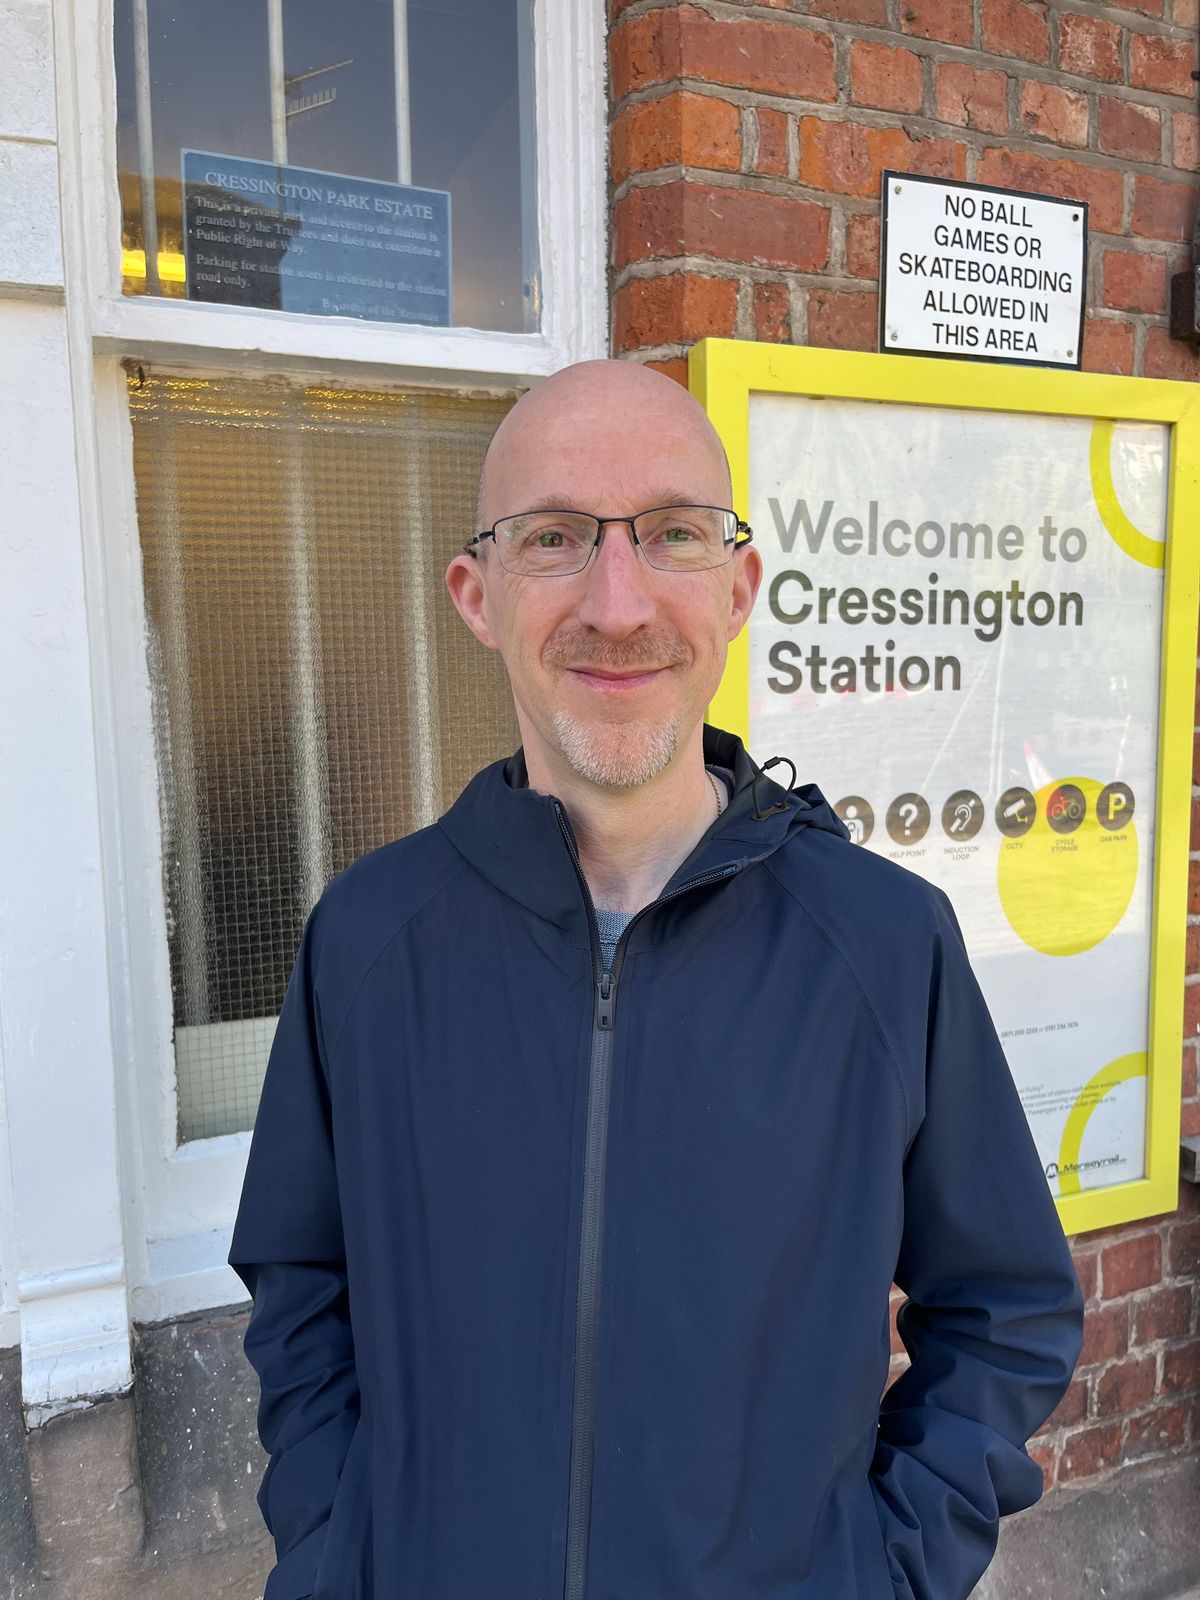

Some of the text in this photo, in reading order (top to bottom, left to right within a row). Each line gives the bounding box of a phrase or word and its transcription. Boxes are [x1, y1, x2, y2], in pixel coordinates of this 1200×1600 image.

[204, 171, 433, 220] CRESSINGTON PARK ESTATE
[194, 195, 219, 208] This
[222, 200, 232, 211] is
[234, 205, 241, 213] a
[243, 206, 281, 218] private
[283, 211, 305, 222] park
[309, 215, 328, 226] and
[364, 224, 375, 233] to
[376, 224, 393, 236] the
[944, 194, 1033, 228] NO BALL
[195, 215, 236, 228] granted
[239, 218, 253, 233] by
[255, 221, 272, 233] the
[274, 223, 318, 240] Trustees
[196, 228, 231, 243] Public
[233, 233, 263, 249] Right
[265, 239, 278, 250] of
[934, 224, 1042, 260] GAMES OR
[196, 253, 238, 272] Parking
[241, 259, 257, 272] for
[259, 264, 294, 276] station
[898, 252, 1072, 294] SKATEBOARDING
[196, 272, 251, 289] road only.
[923, 289, 1049, 324] ALLOWED IN
[932, 322, 1039, 353] THIS AREA
[767, 497, 1087, 563] Welcome to
[768, 569, 1083, 642] Cressington
[767, 639, 961, 695] Station
[906, 849, 926, 857] POINT
[943, 845, 980, 855] INDUCTION
[1005, 841, 1024, 850] CCTV
[1055, 838, 1075, 847] CYCLE
[952, 853, 970, 861] LOOP
[1063, 1154, 1120, 1173] Merseyrail
